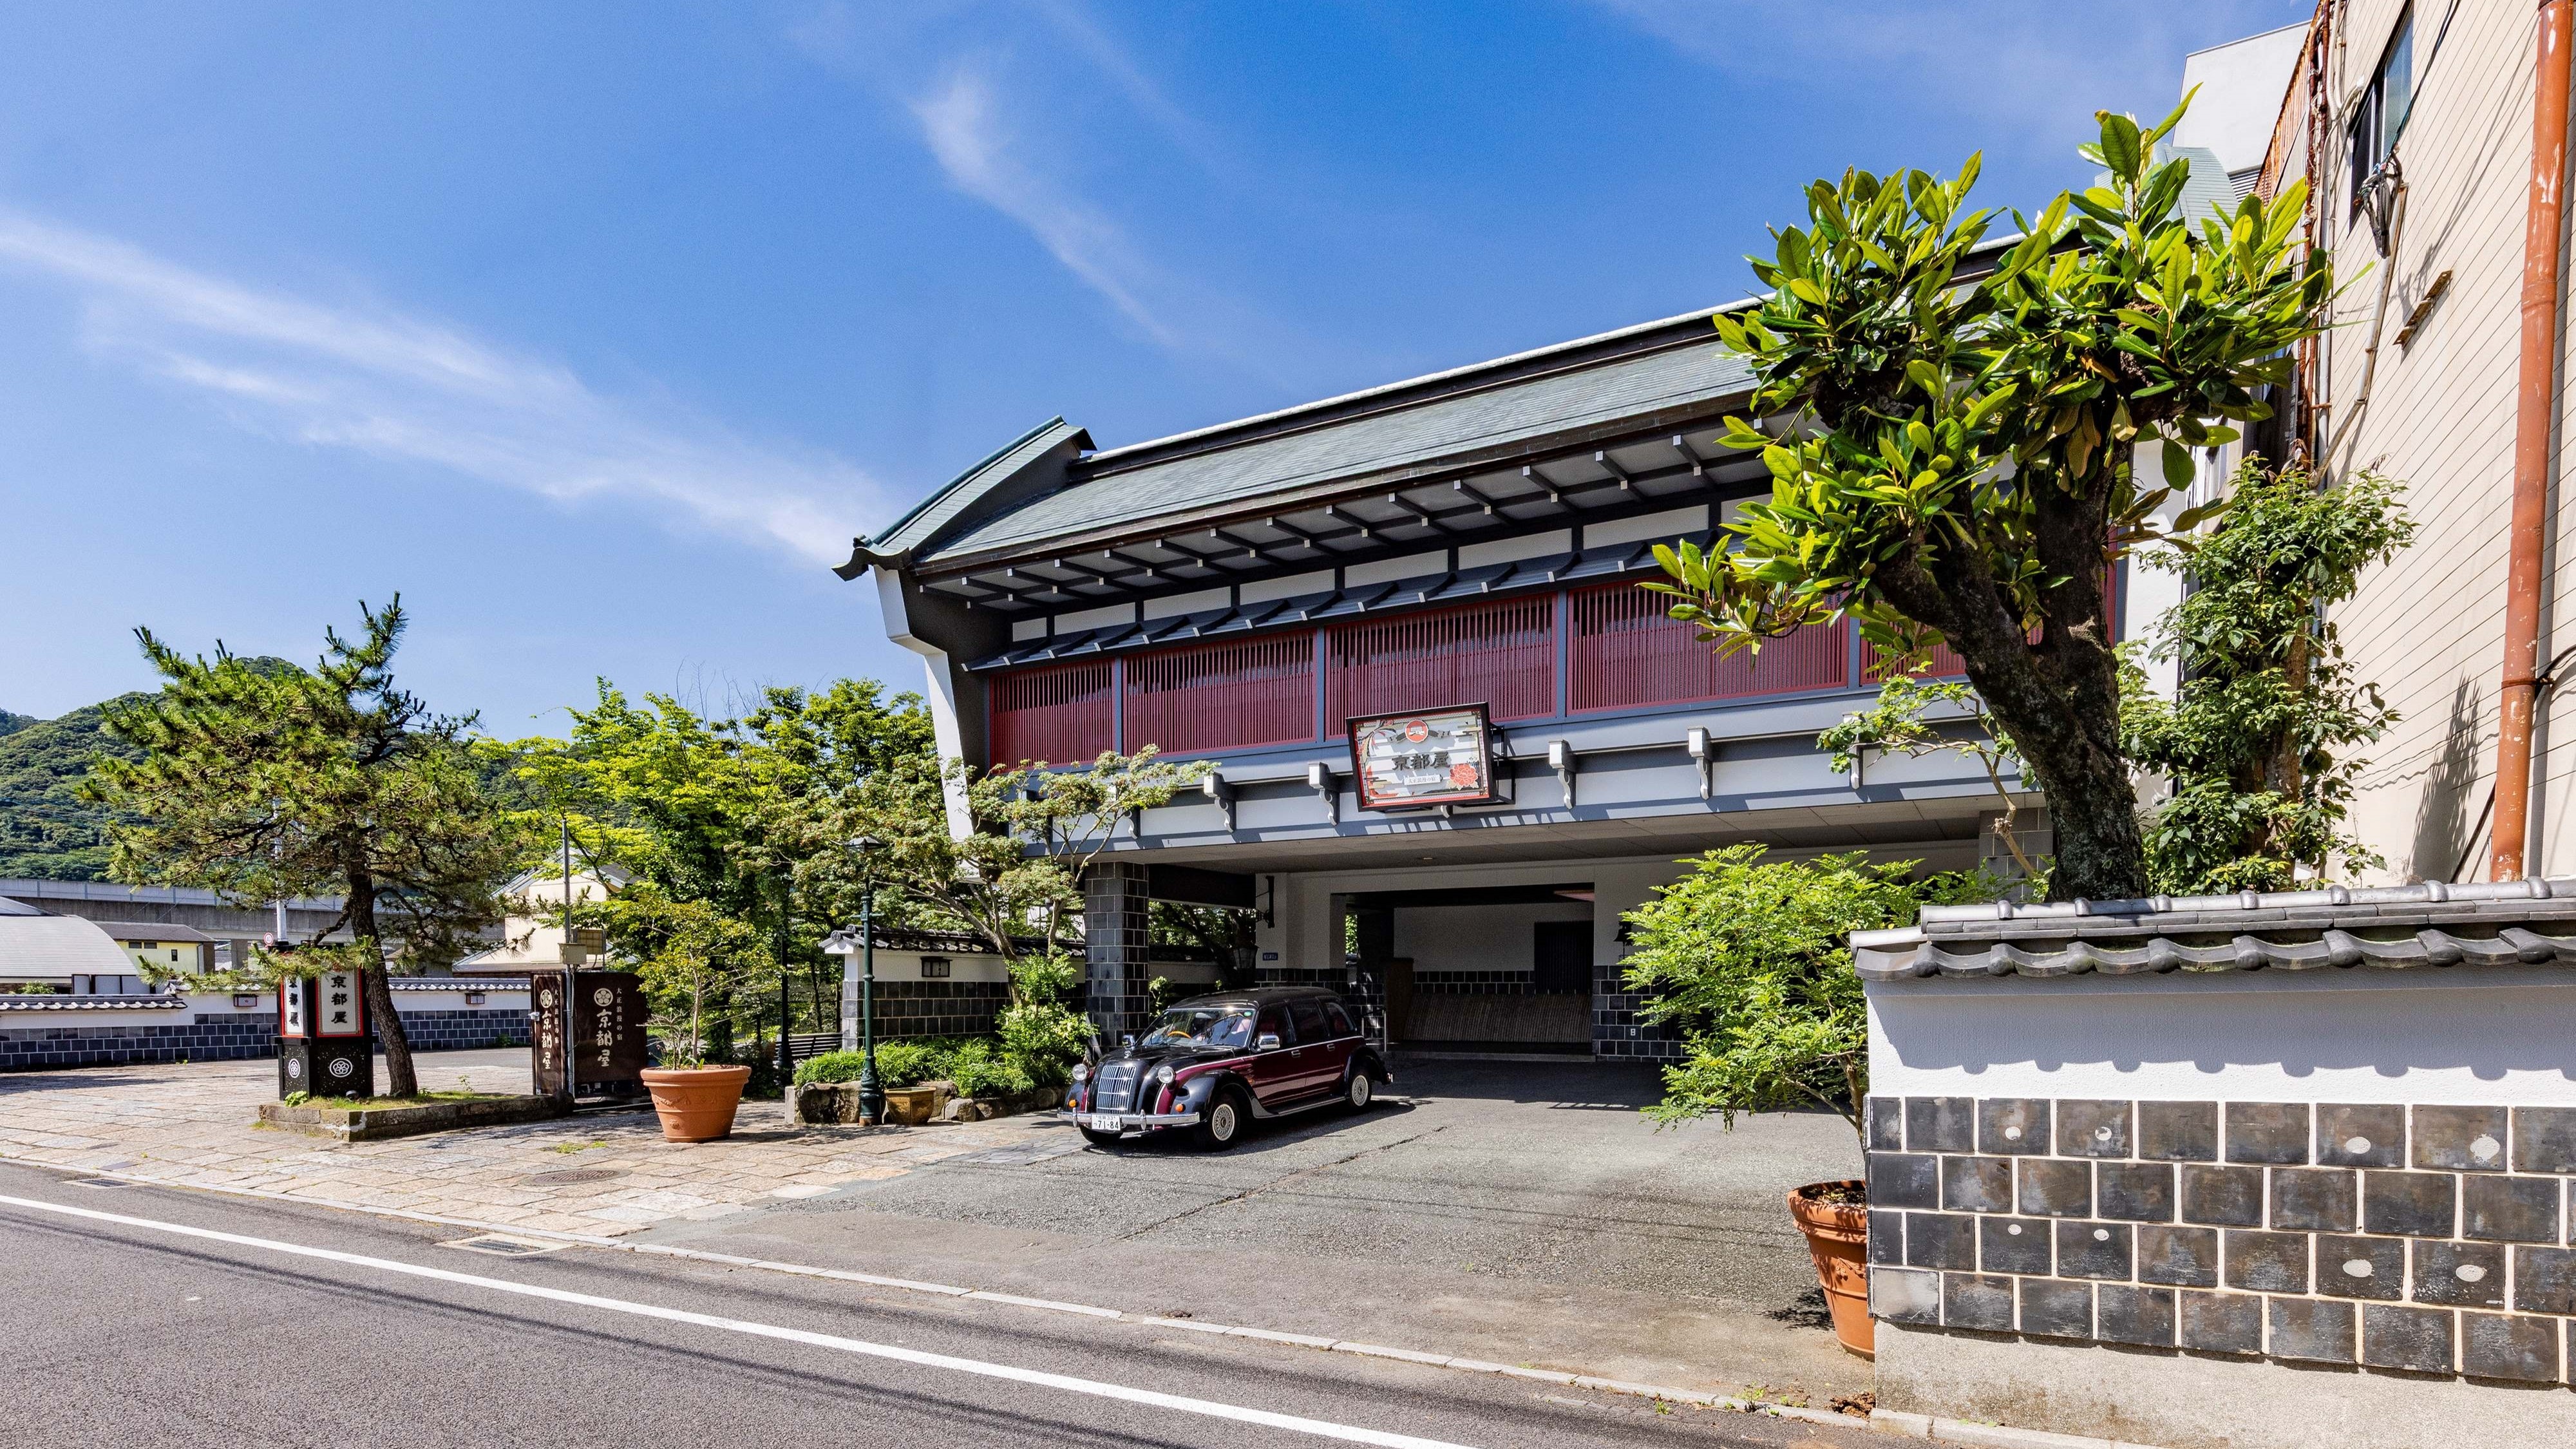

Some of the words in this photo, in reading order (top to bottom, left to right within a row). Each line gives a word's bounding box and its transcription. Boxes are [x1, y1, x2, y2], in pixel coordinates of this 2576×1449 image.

[1392, 752, 1450, 771] 京都屋
[330, 975, 348, 1024] 京都屋
[542, 1010, 553, 1070] 京都屋
[596, 1009, 613, 1067] 京都屋
